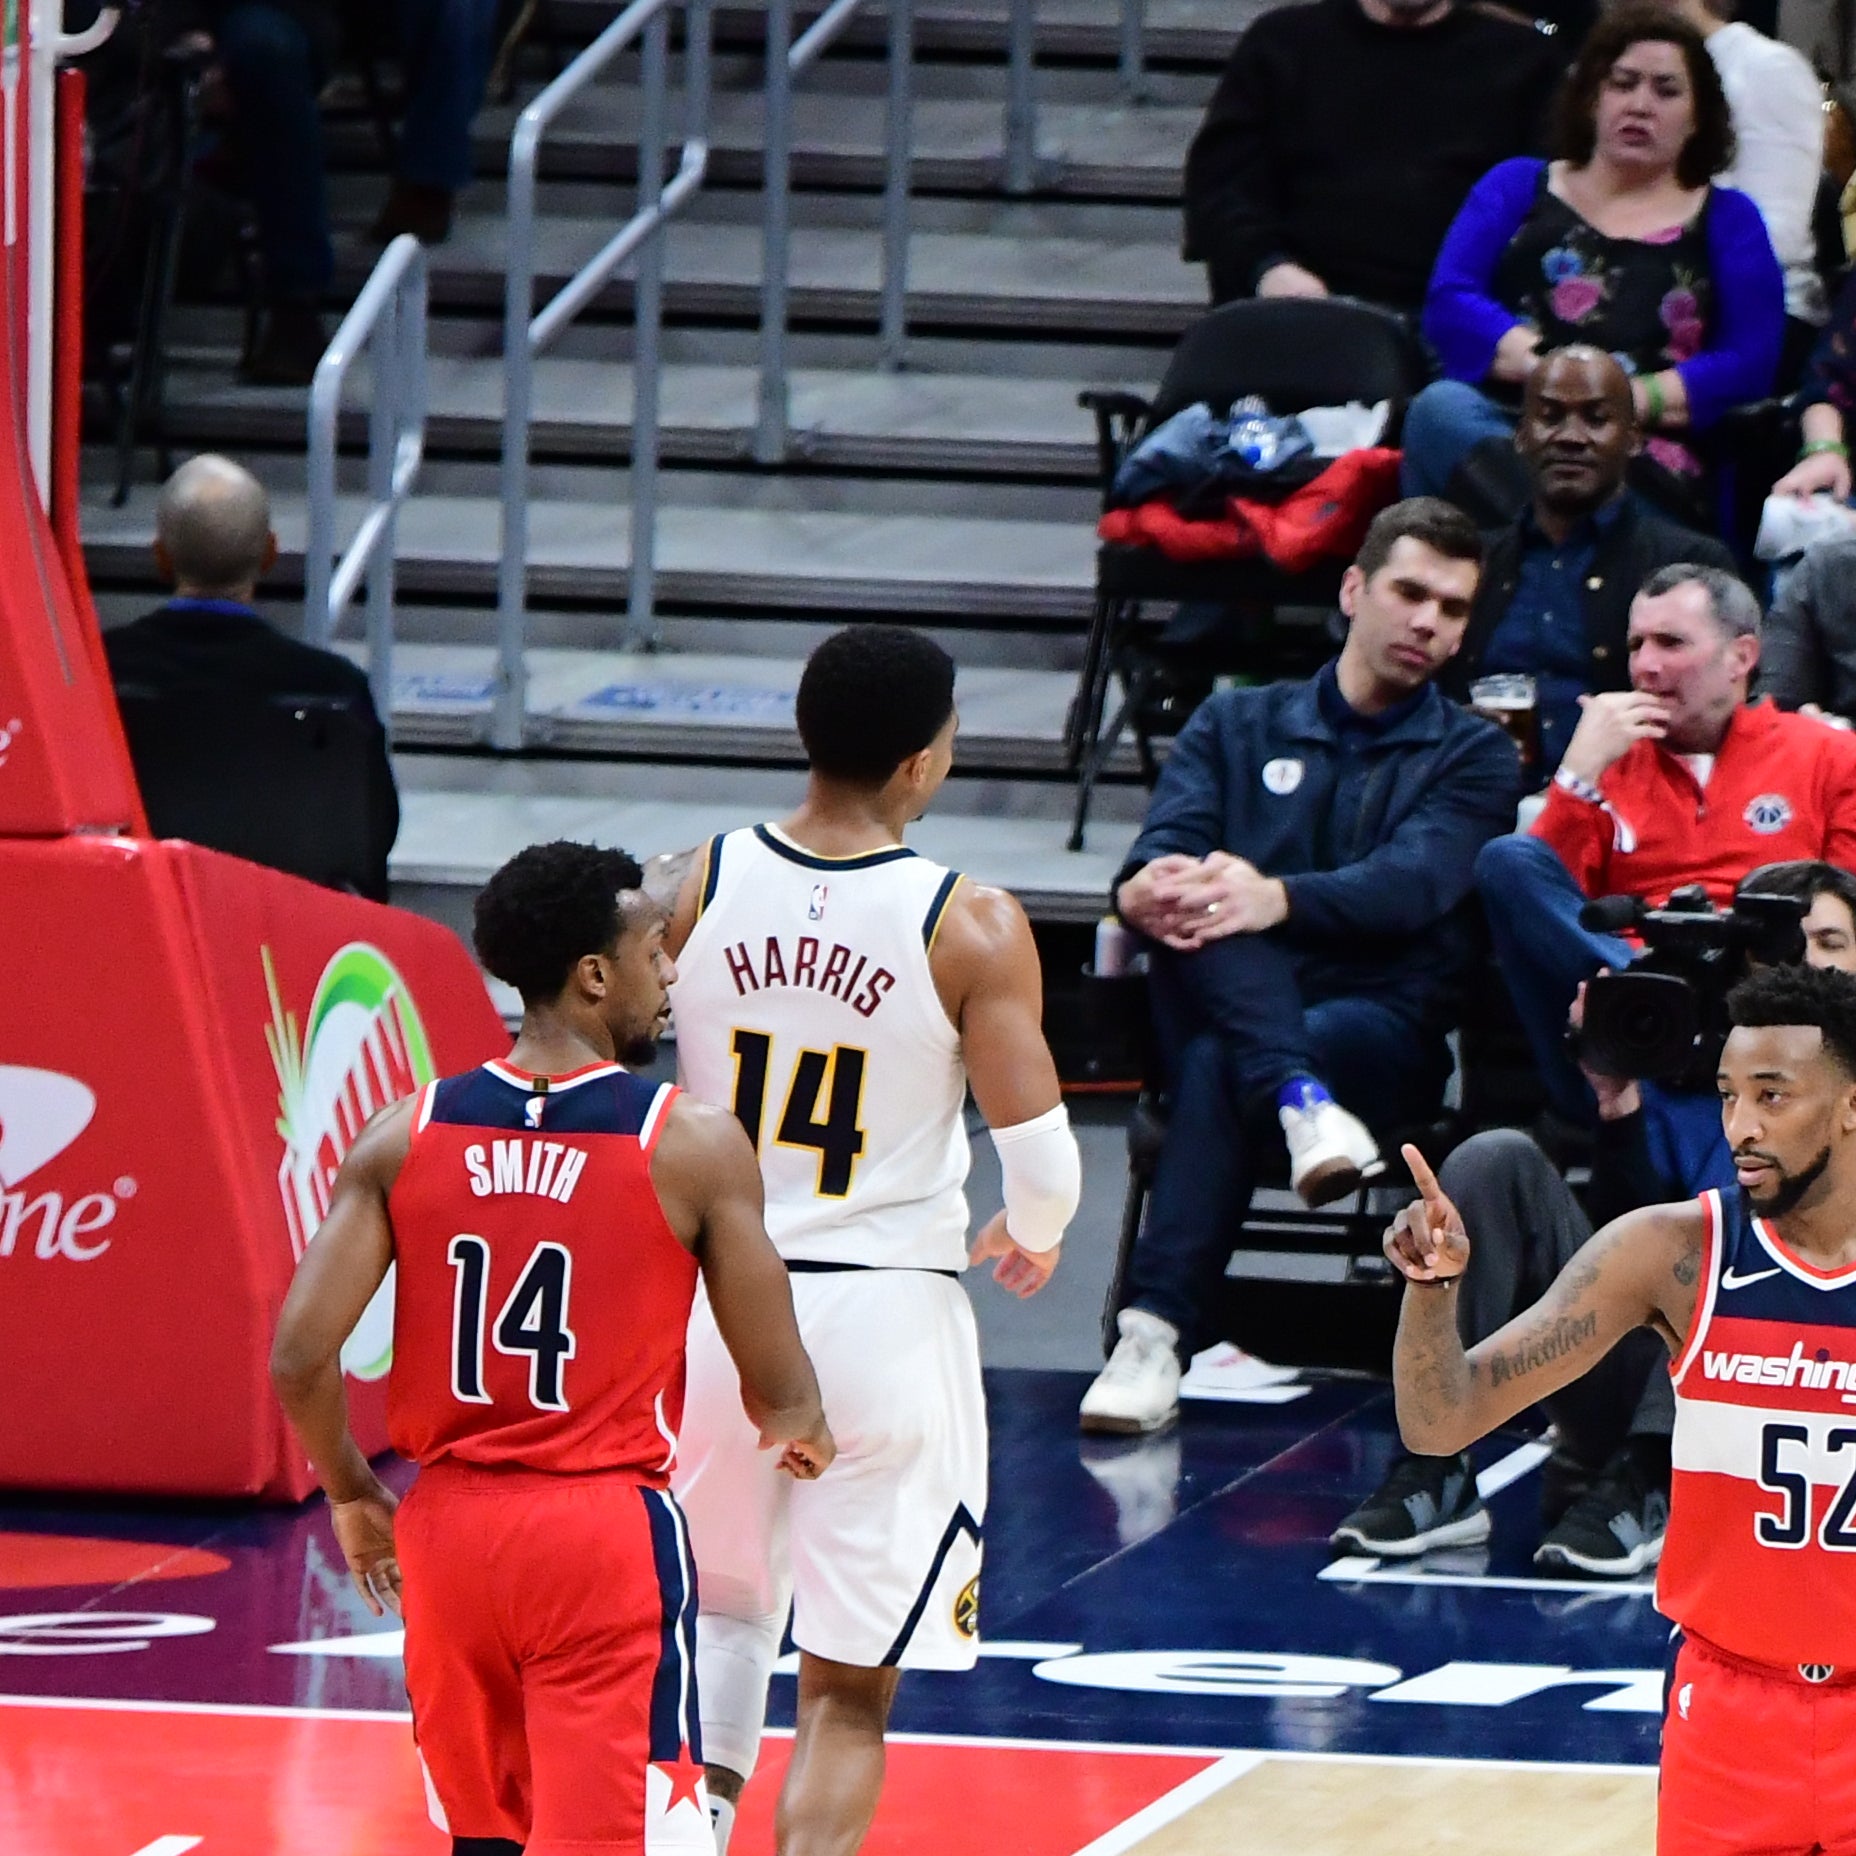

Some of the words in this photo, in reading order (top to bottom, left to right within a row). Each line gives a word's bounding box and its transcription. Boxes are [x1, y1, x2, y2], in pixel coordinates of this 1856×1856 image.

[724, 936, 896, 1018] HARRIS
[464, 1139, 588, 1203] SMITH
[728, 1025, 868, 1199] 14
[447, 1234, 576, 1412] 14
